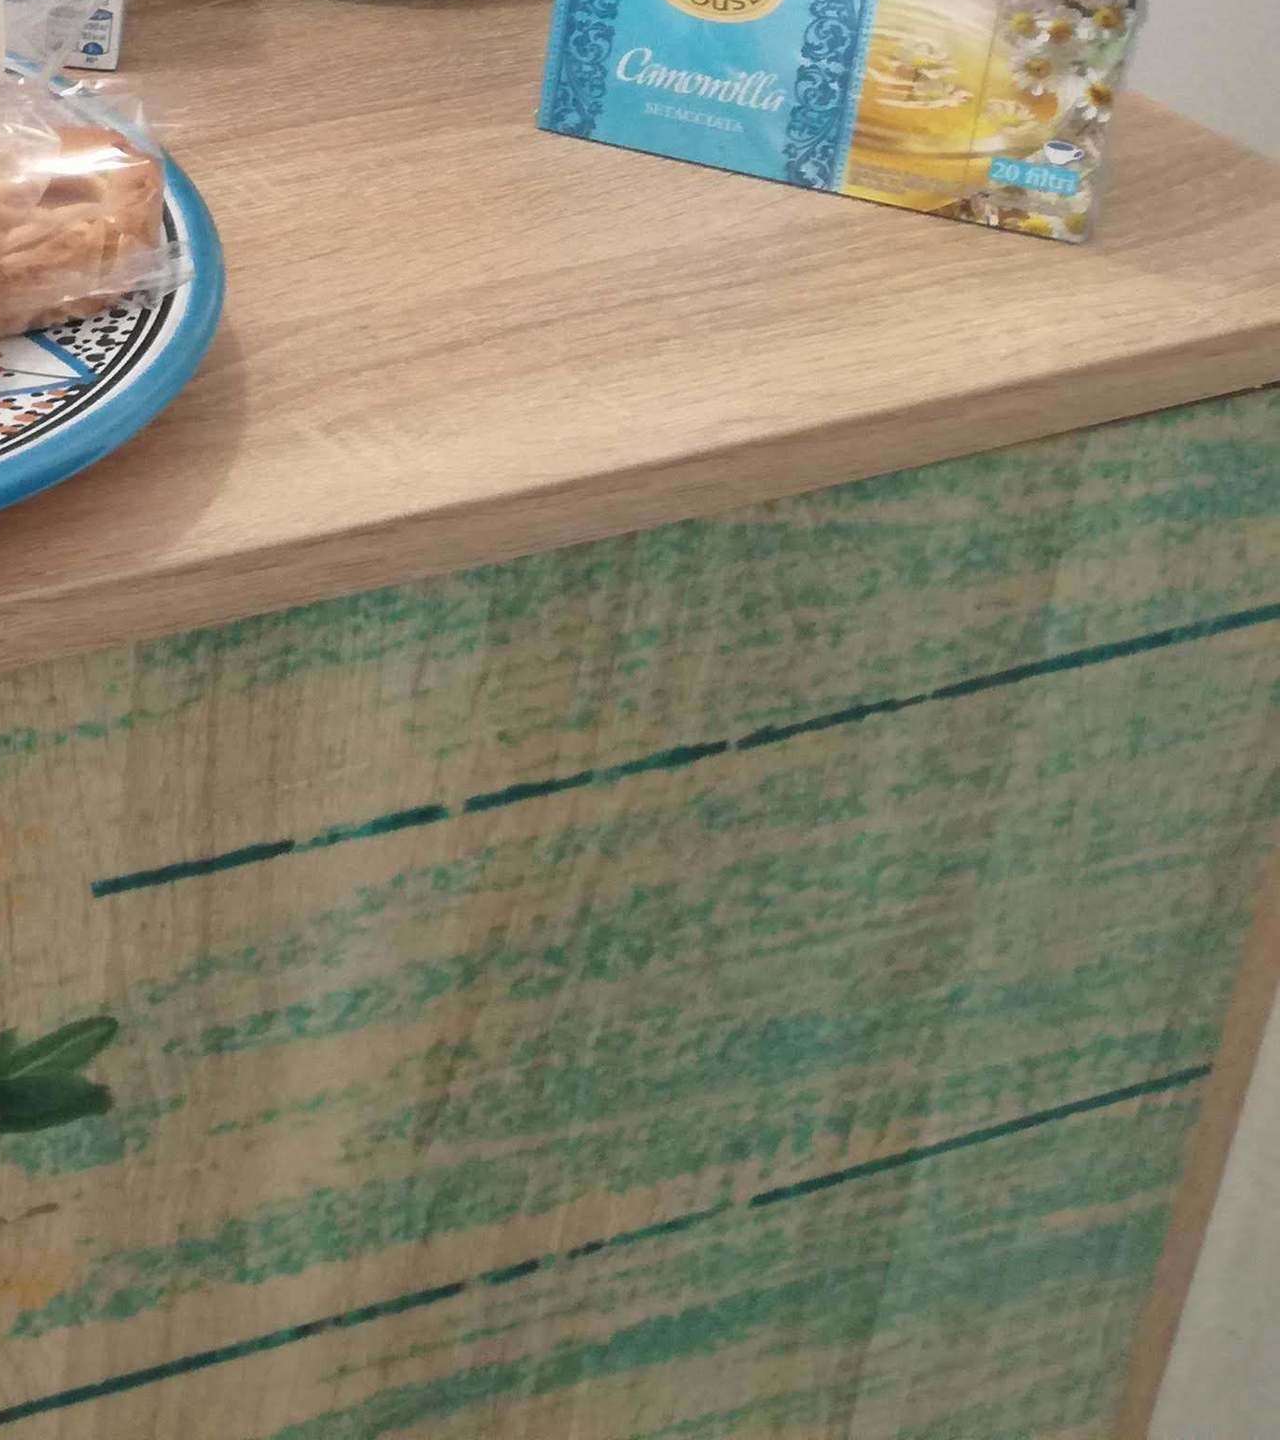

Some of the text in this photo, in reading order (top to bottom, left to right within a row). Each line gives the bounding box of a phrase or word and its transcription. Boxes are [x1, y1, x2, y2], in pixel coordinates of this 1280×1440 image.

[616, 47, 787, 112] Camomilla
[991, 160, 1076, 192] 20 filtri
